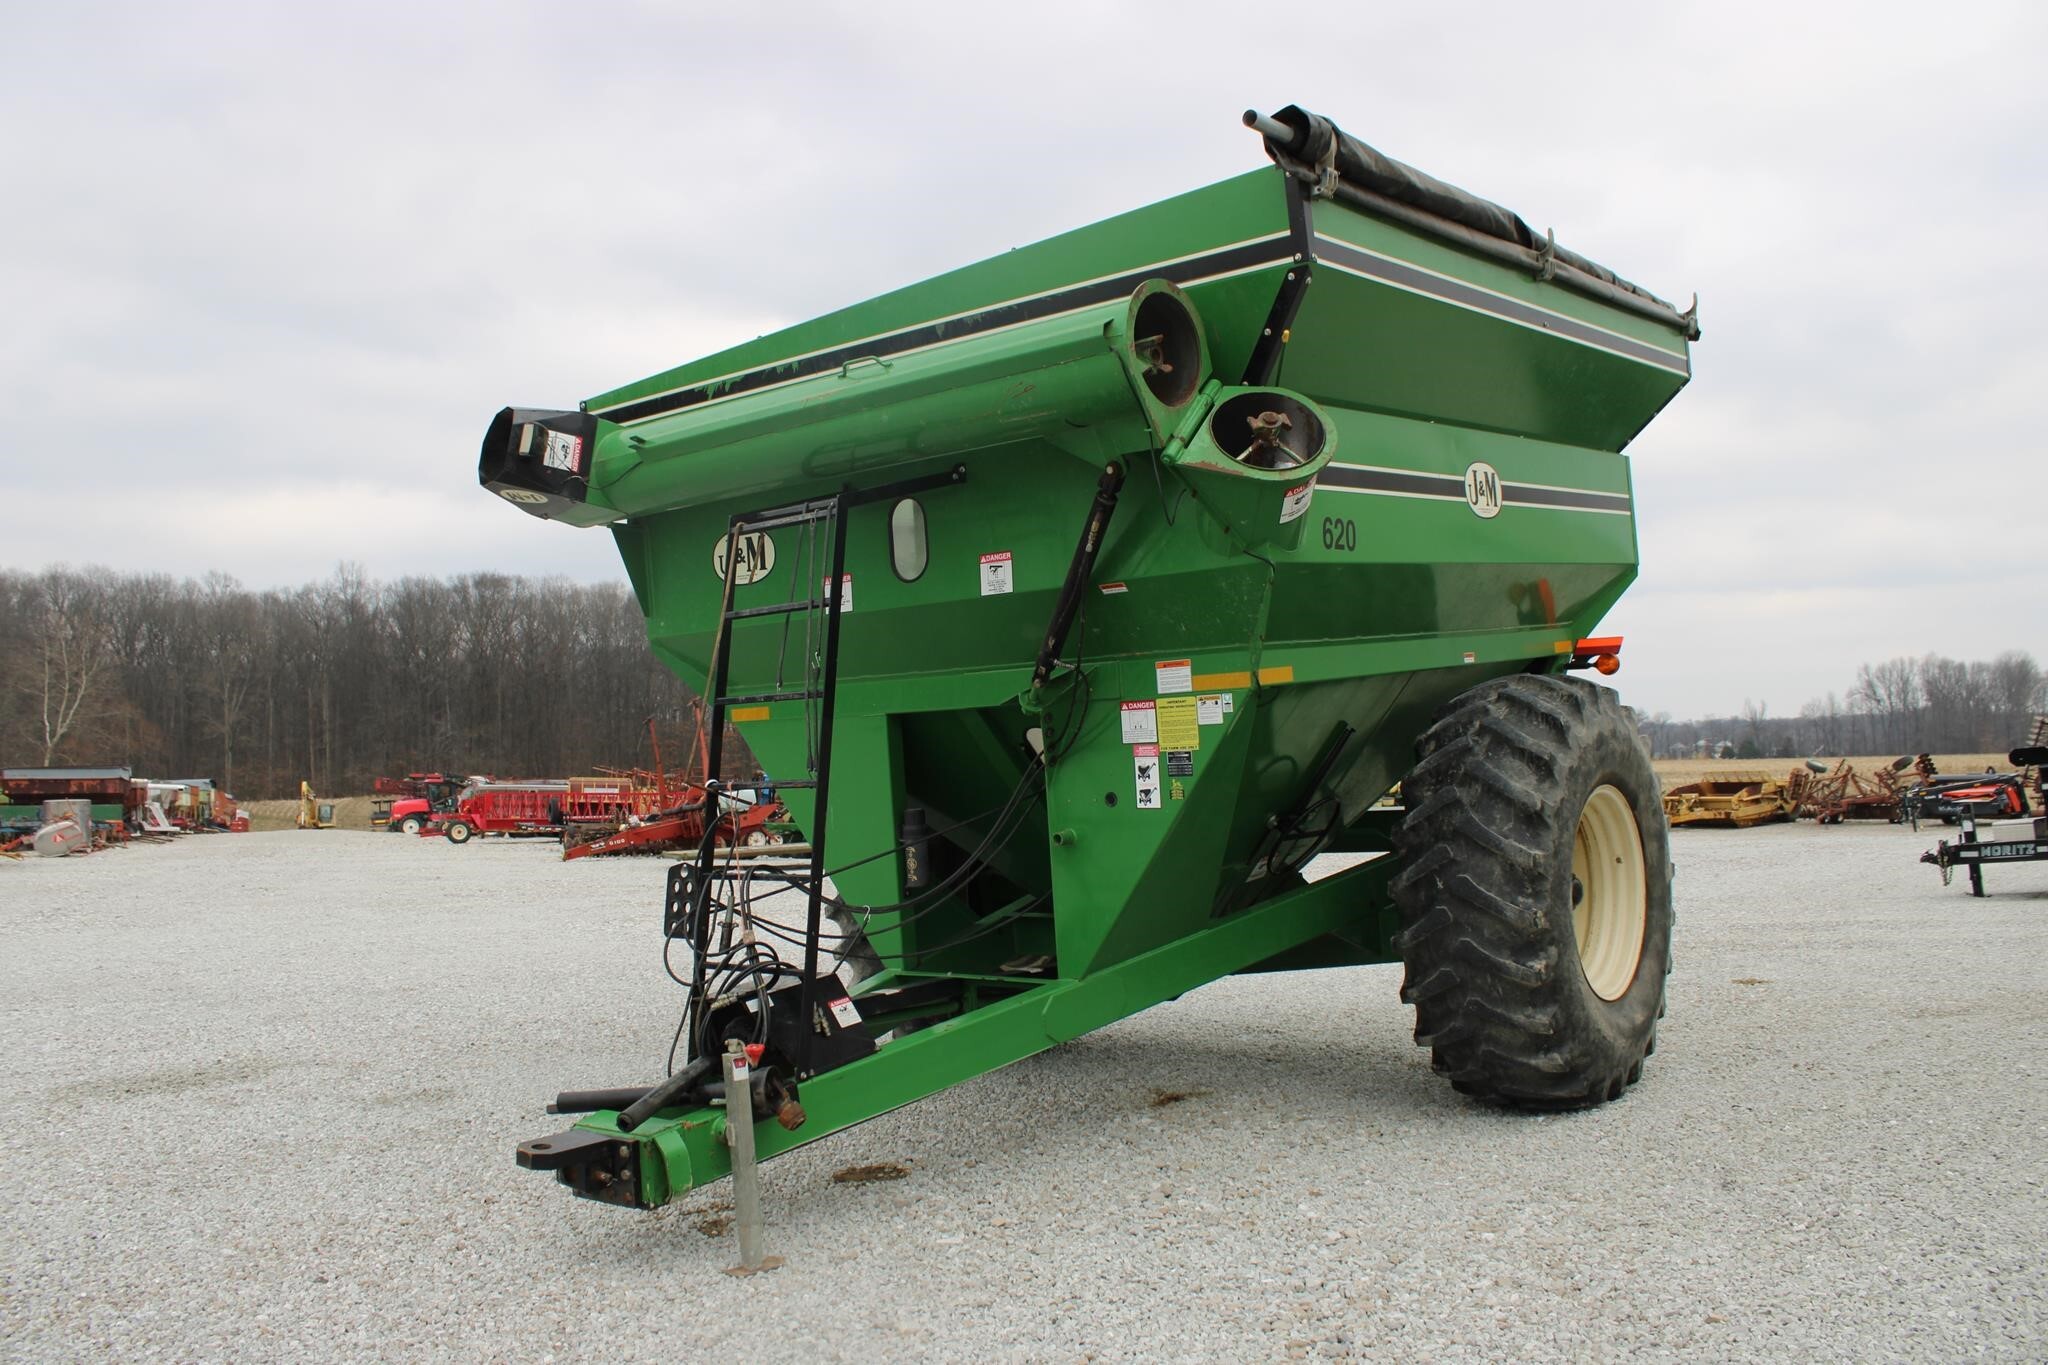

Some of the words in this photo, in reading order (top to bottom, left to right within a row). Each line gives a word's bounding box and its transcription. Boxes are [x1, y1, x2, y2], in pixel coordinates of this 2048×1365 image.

[571, 444, 583, 473] DANGER
[1467, 469, 1499, 508] J&M
[1322, 516, 1356, 552] 620
[985, 552, 1011, 562] DANGER
[1128, 702, 1155, 710] DANGER
[1980, 844, 2036, 857] MORITZ
